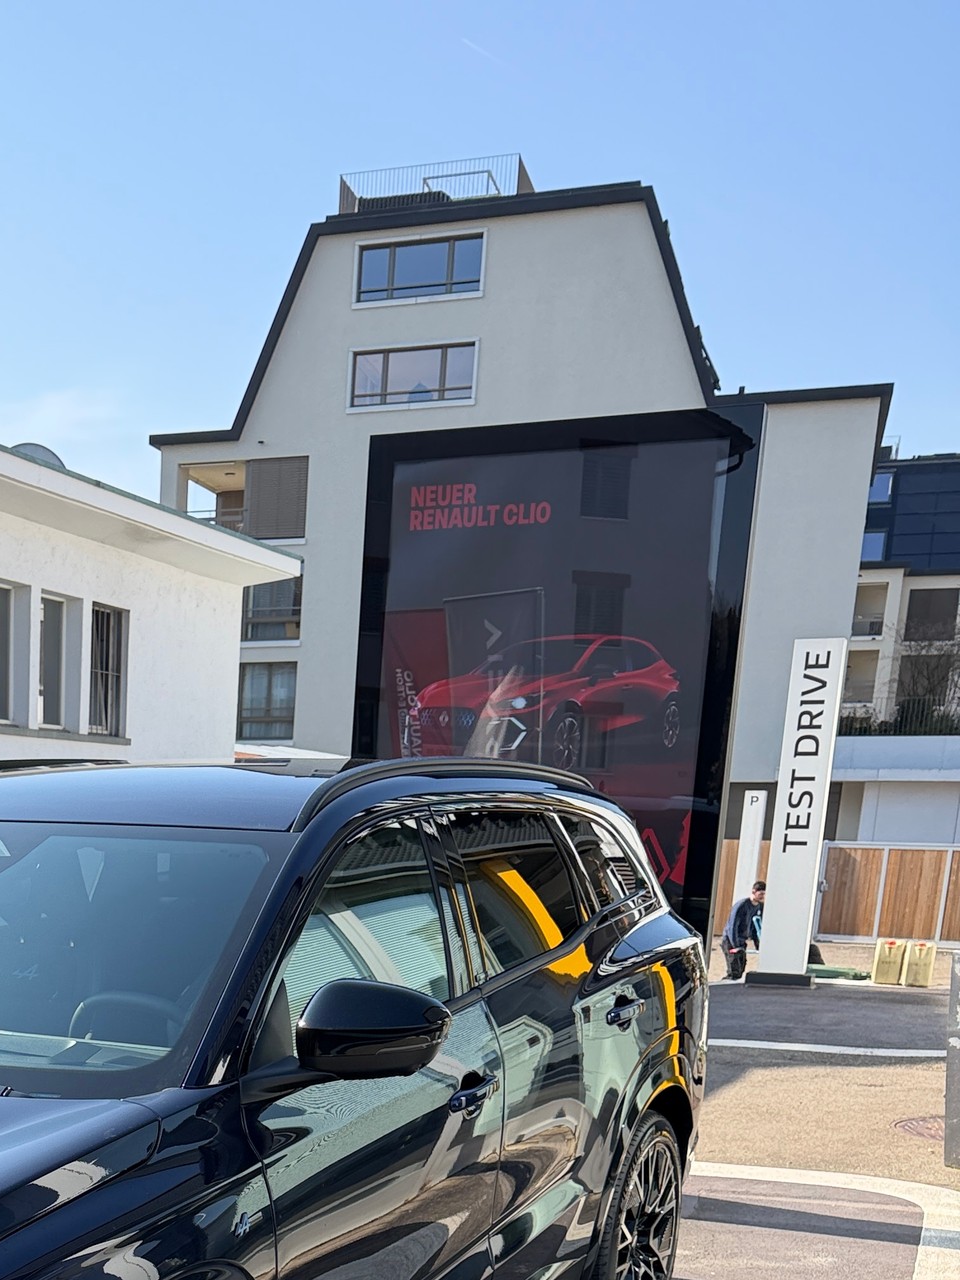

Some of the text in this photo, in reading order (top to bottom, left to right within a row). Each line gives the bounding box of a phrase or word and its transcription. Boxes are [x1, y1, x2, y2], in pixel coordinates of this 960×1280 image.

[410, 483, 477, 507] NEUER
[409, 501, 552, 531] RENAULT CLIO
[782, 650, 832, 853] TEST DRIVE
[750, 796, 760, 806] P
